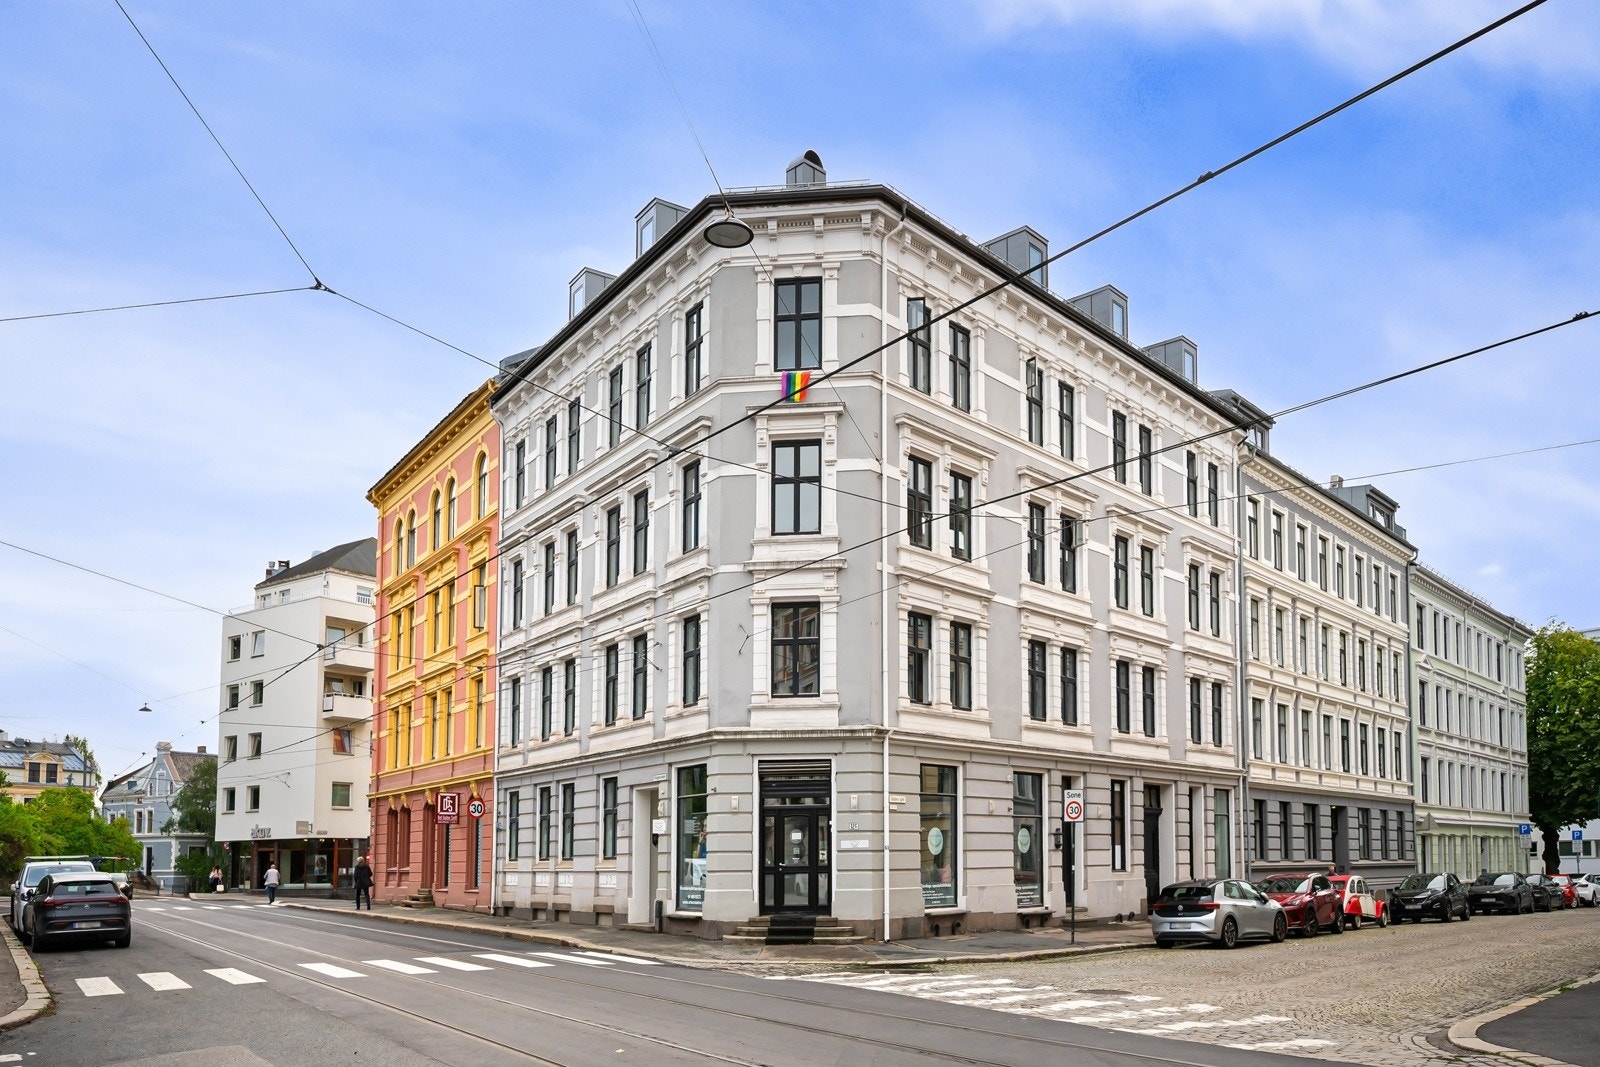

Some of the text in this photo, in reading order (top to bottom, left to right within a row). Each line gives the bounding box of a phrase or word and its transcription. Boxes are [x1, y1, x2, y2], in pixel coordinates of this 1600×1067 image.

[470, 803, 483, 814] 30
[1069, 806, 1079, 815] 30
[1521, 825, 1528, 834] P
[1574, 831, 1580, 839] P
